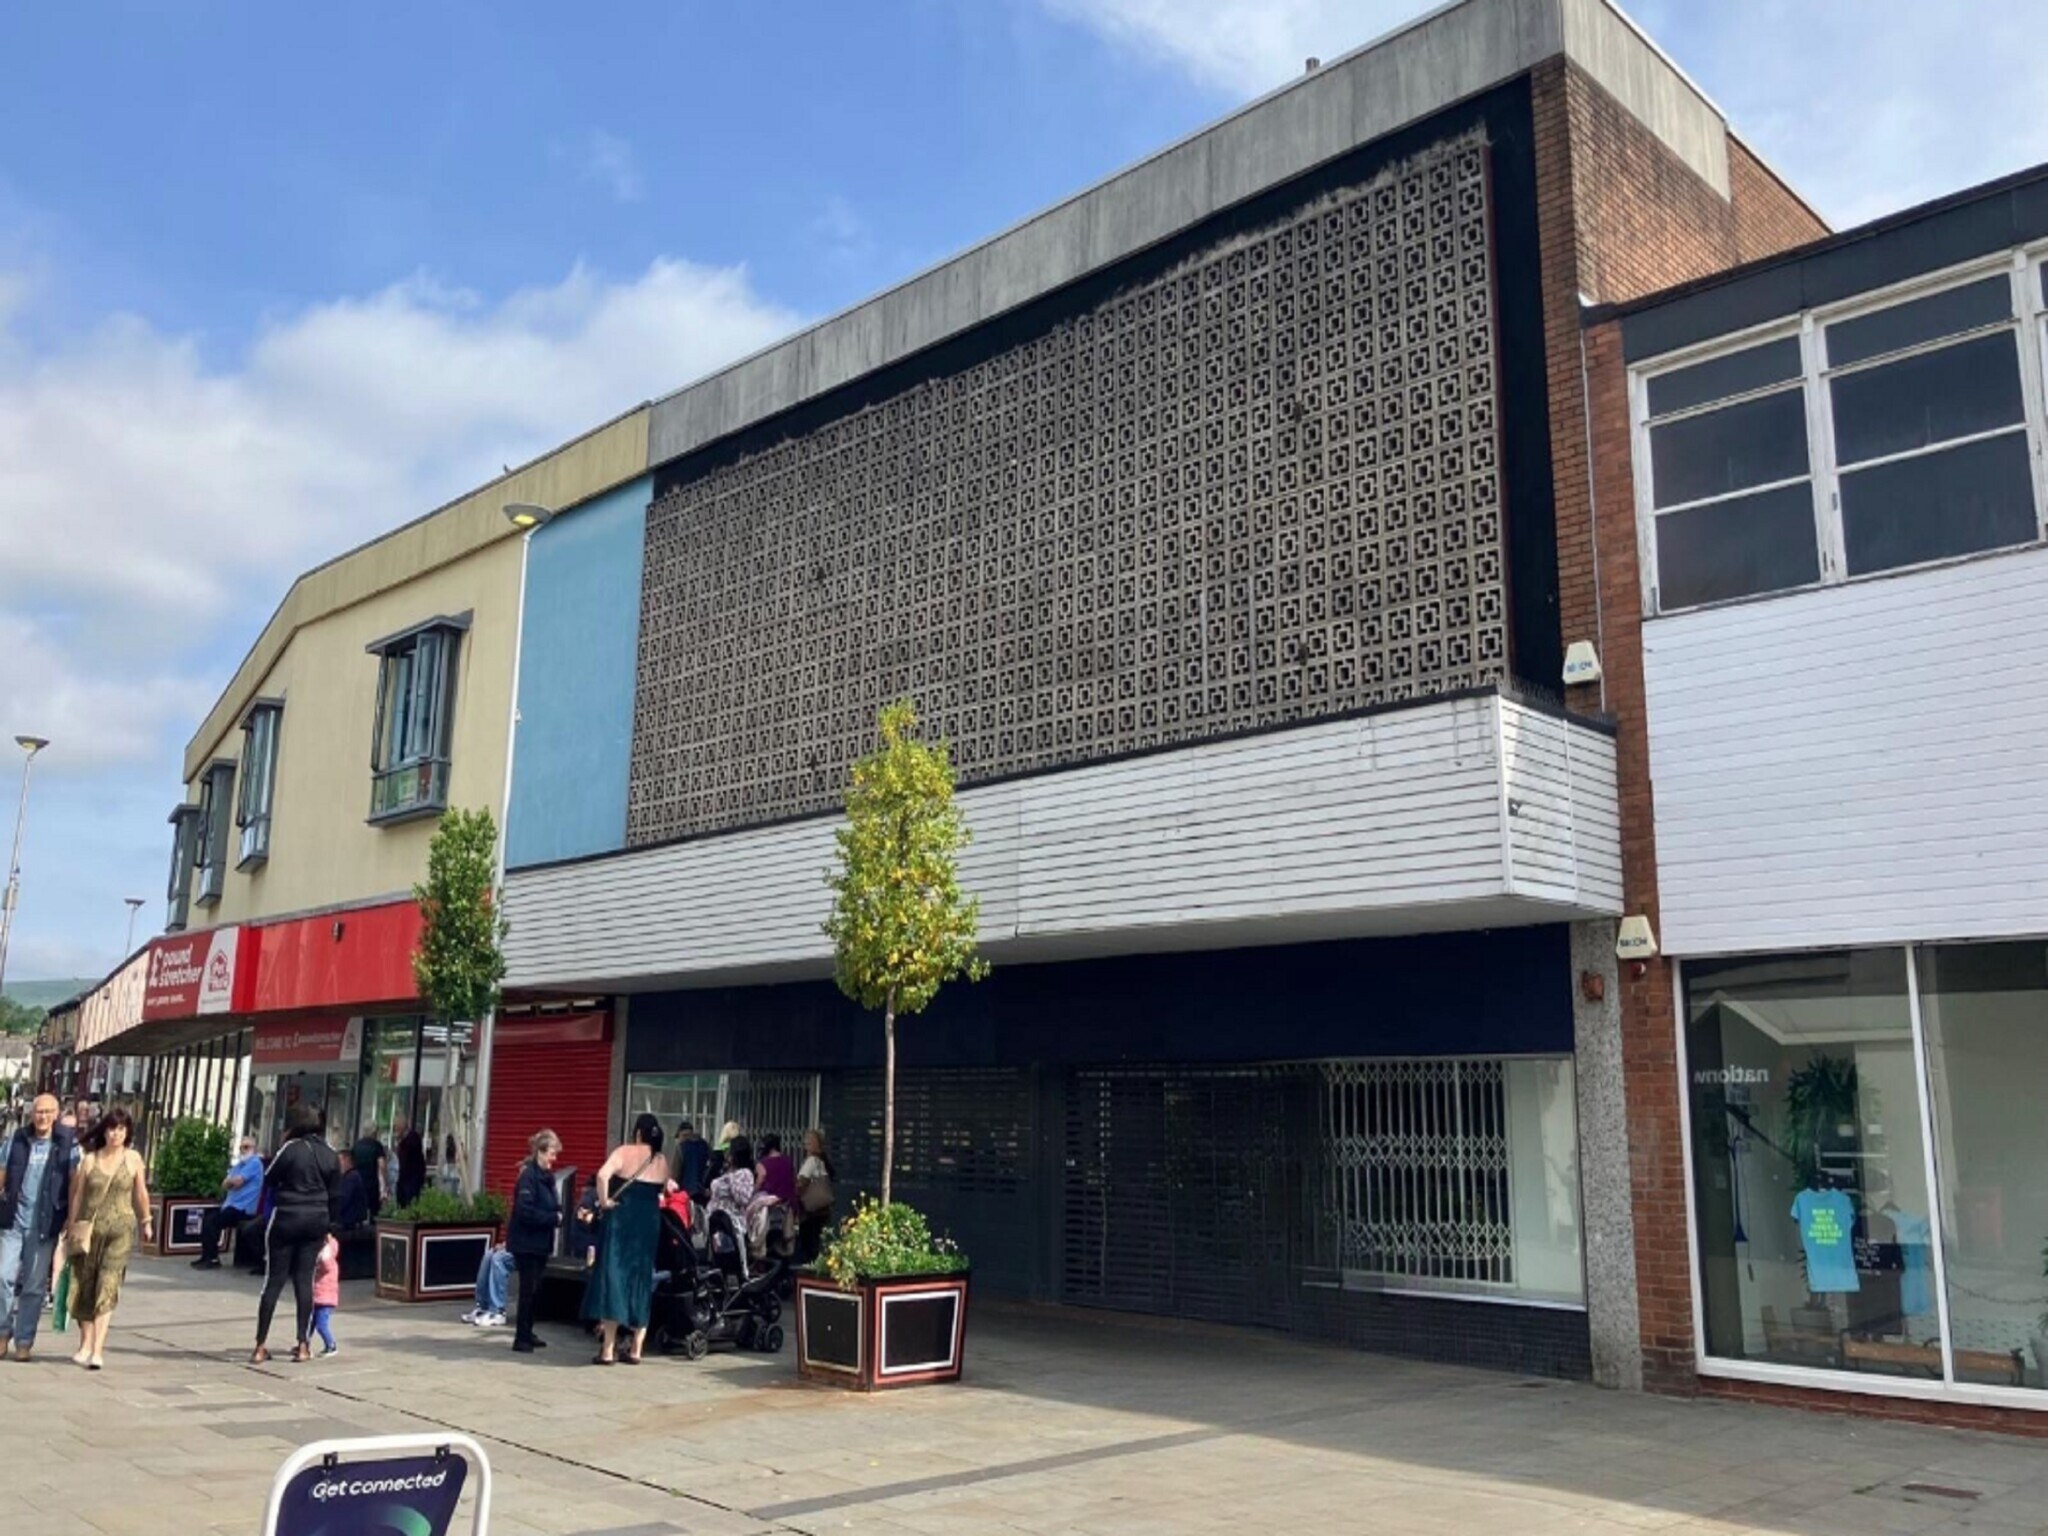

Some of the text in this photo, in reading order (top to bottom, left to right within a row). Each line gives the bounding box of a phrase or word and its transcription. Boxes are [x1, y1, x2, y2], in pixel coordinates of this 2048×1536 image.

[162, 942, 194, 971] pound
[159, 966, 203, 987] stretcher
[312, 1470, 447, 1498] Get connected
